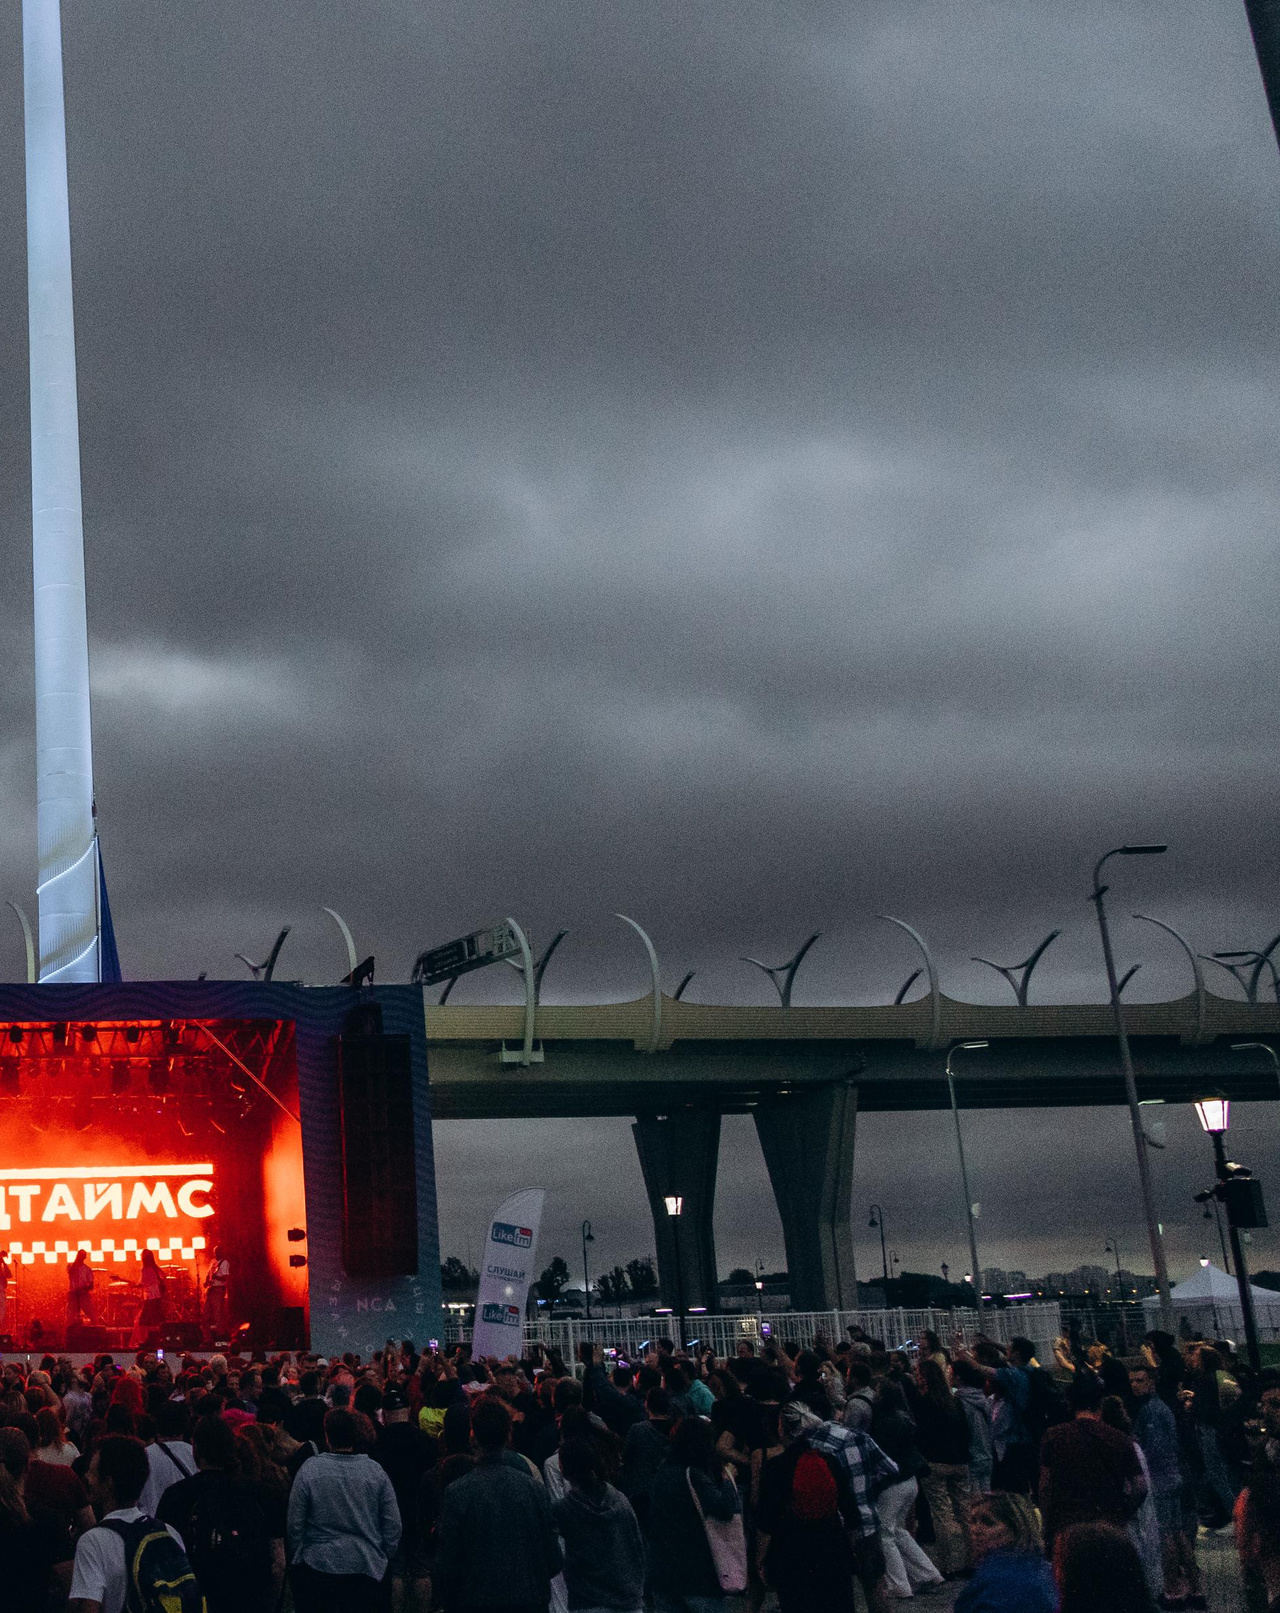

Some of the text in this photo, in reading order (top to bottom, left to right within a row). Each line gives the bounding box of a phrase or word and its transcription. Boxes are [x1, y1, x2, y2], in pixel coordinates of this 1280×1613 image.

[493, 1228, 513, 1242] Like
[515, 1232, 529, 1246] fm
[487, 1265, 525, 1280] СЛУШАЙ
[357, 1297, 397, 1313] NCA
[484, 1308, 502, 1321] Like
